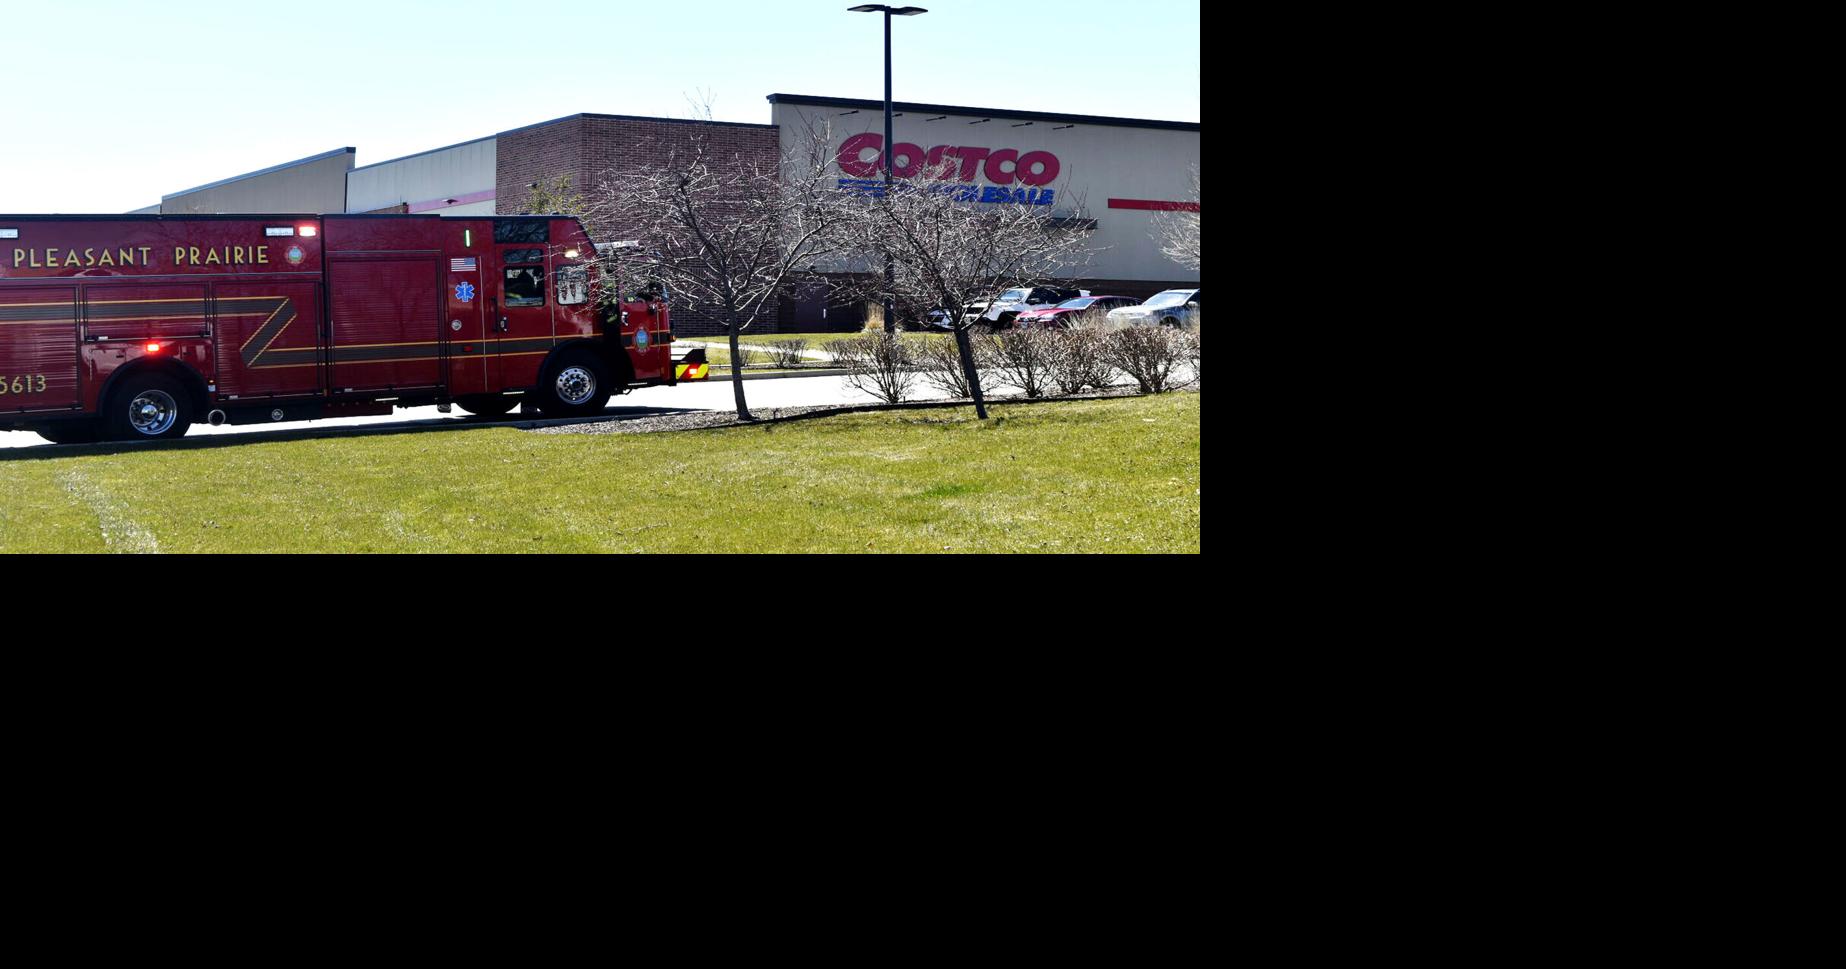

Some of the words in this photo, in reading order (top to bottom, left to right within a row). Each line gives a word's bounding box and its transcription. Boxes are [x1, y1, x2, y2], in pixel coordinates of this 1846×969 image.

[837, 132, 1061, 187] COSTCO
[13, 246, 152, 268] PLEASANT
[175, 245, 270, 265] PRAIRIE
[0, 374, 47, 395] 5613
